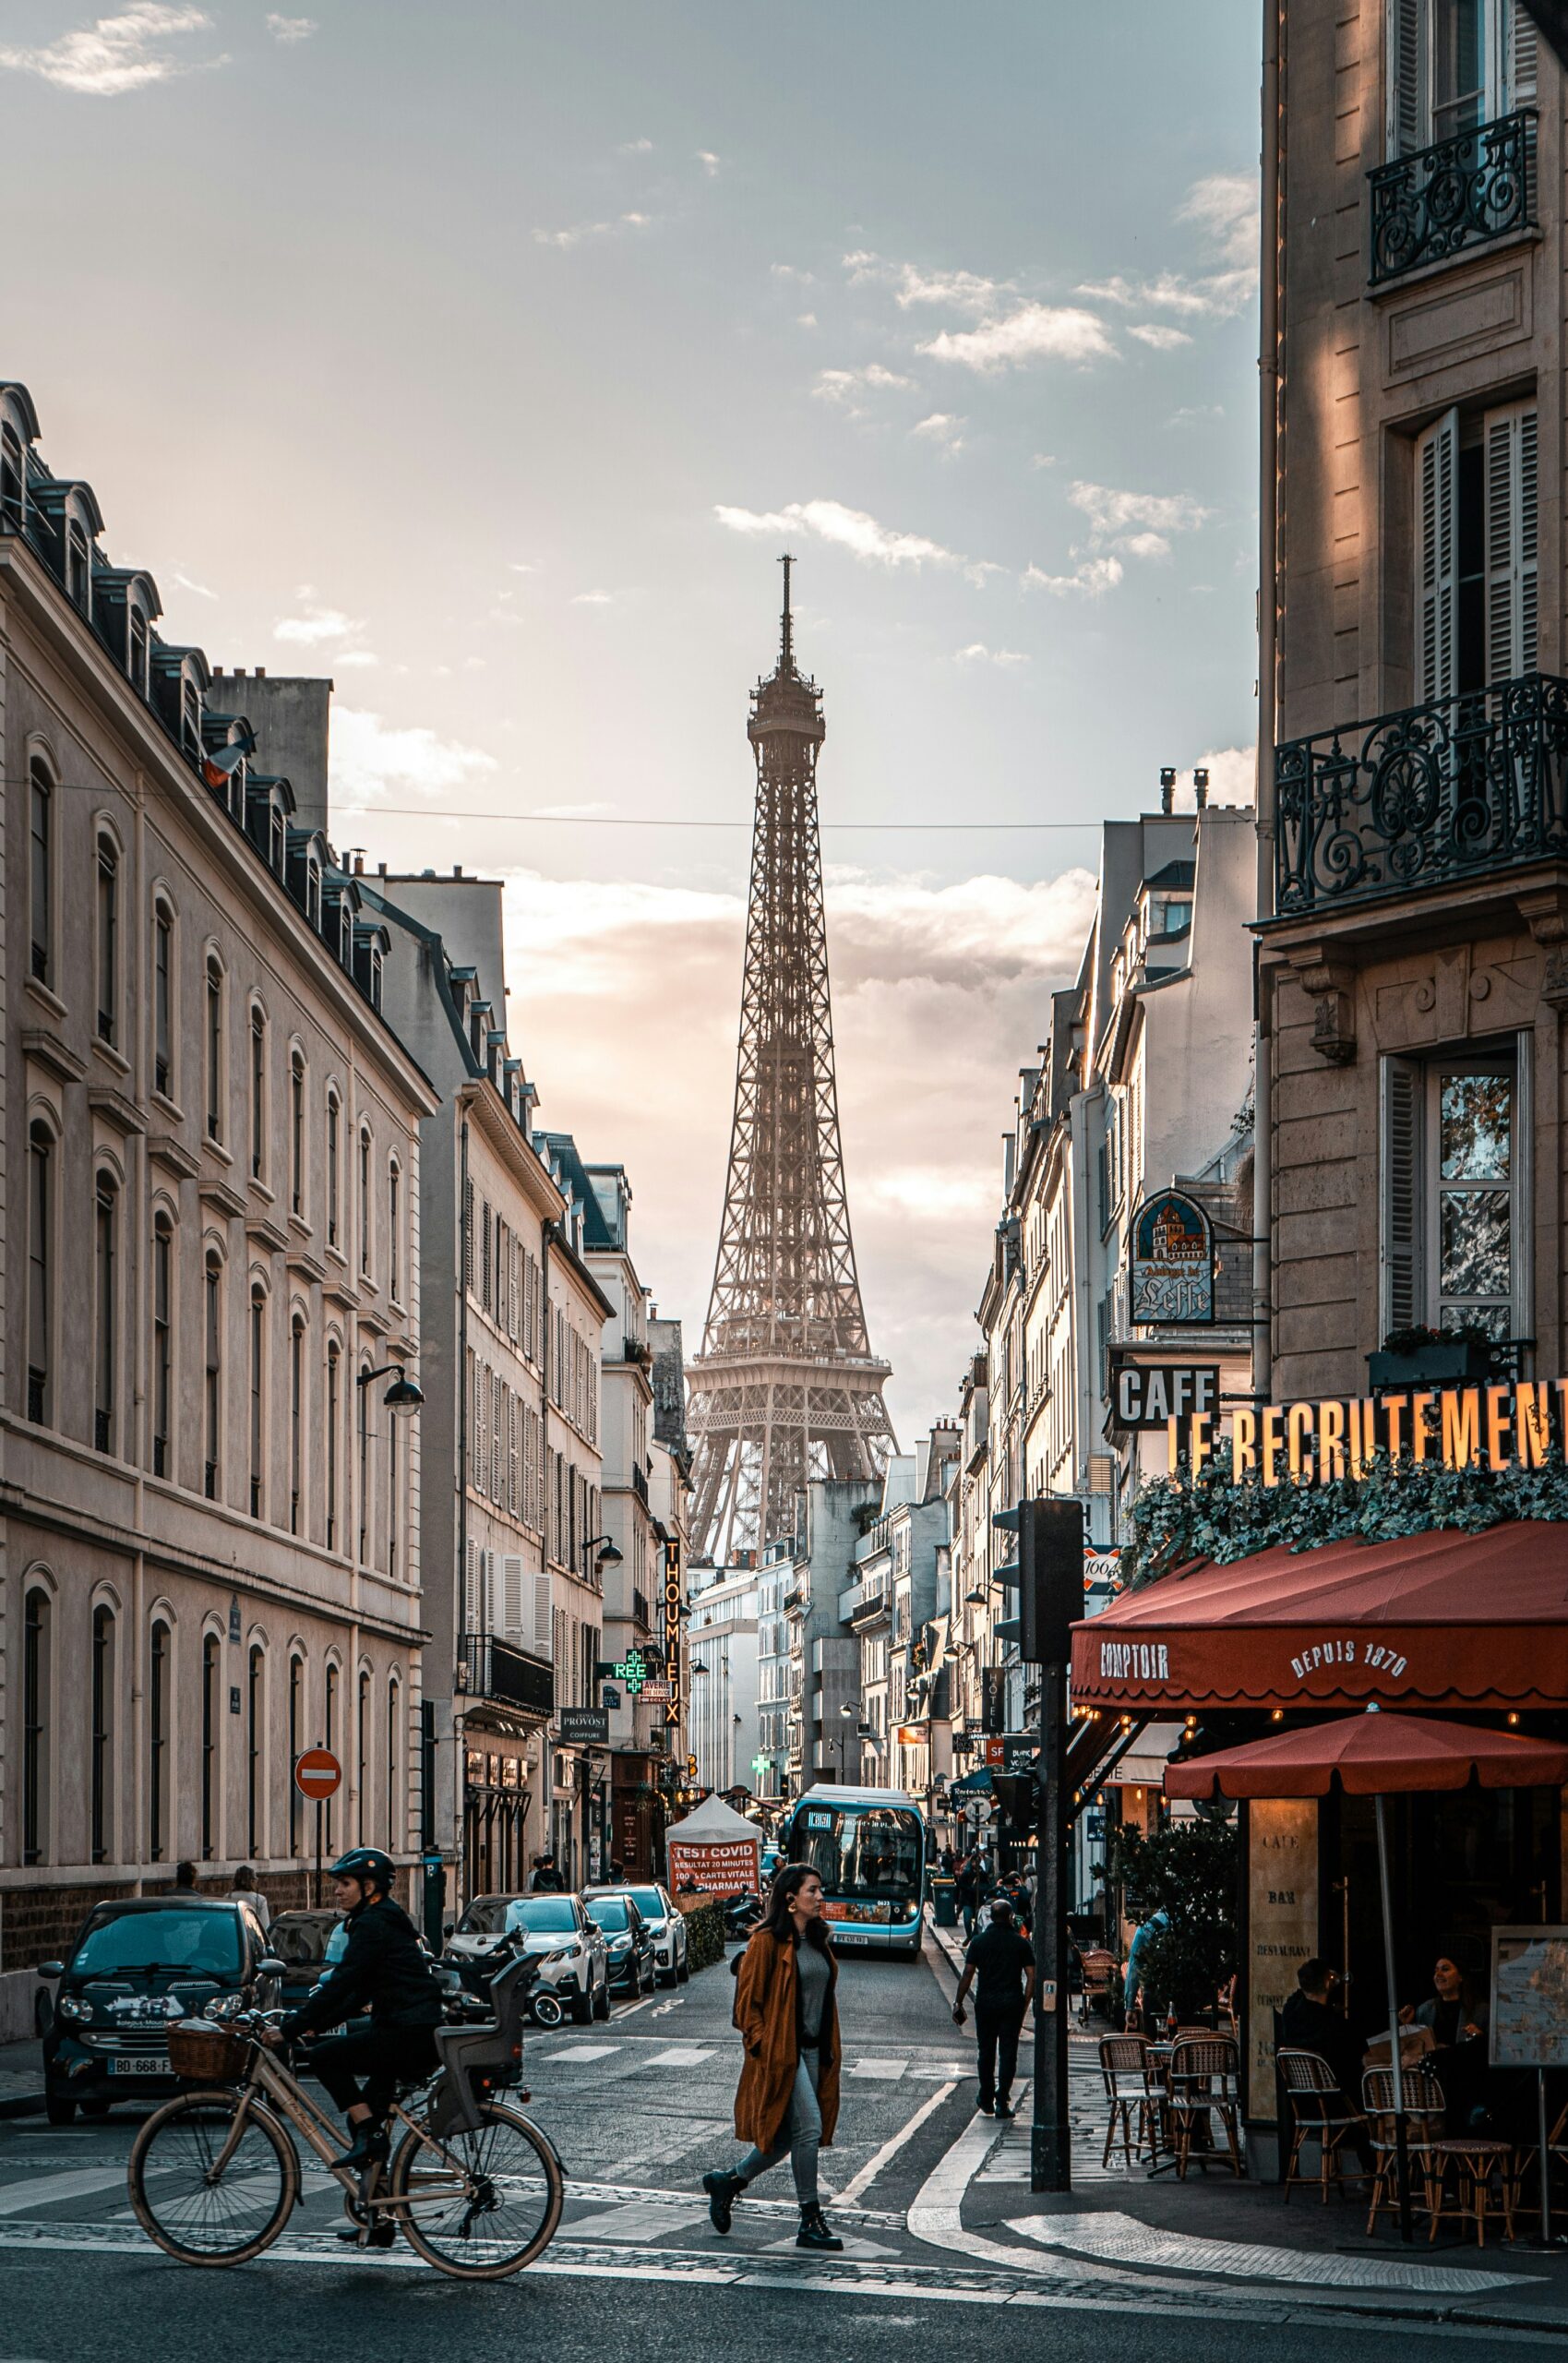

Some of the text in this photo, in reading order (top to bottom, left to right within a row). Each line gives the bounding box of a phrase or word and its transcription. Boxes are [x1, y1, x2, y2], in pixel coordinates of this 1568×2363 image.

[1134, 1278, 1210, 1318] Leffe
[1101, 1642, 1169, 1679] COMPTOIR
[1290, 1641, 1407, 1678] DEPUIS 1870
[643, 1681, 670, 1689] AVERIE
[563, 1717, 607, 1726] PROVOST
[674, 1844, 753, 1859] TEST COVID
[675, 1861, 711, 1869] RESULTAT
[721, 1859, 754, 1867] MINUTES
[700, 1871, 726, 1879] CARTE
[727, 1870, 754, 1878] VITALE
[1268, 1890, 1296, 1904] BAR
[1257, 1945, 1311, 1957] RESTAURANT
